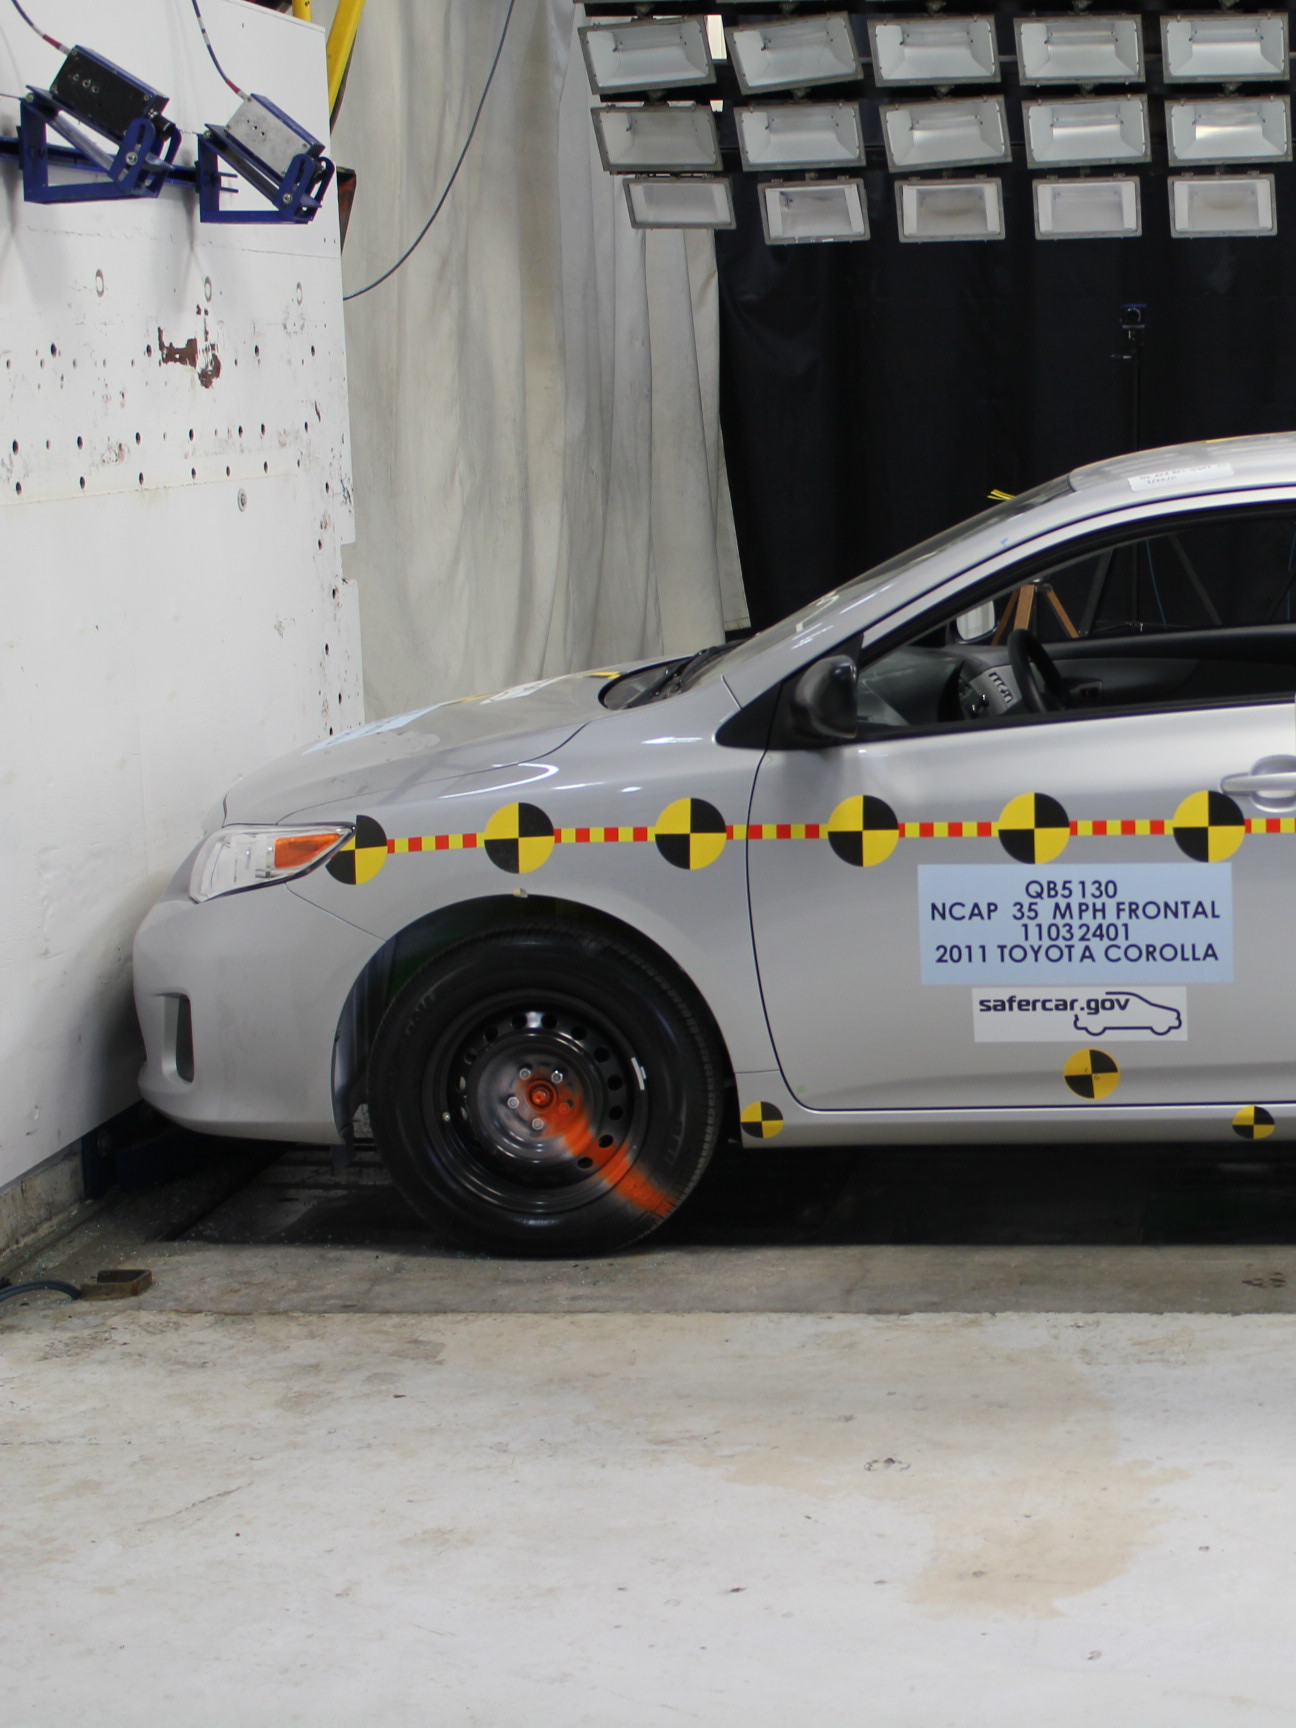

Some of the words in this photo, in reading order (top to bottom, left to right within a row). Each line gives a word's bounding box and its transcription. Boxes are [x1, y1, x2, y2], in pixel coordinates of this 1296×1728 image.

[1025, 880, 1118, 899] QB5130
[930, 902, 998, 921] NCAP
[1012, 902, 1039, 920] 35
[1052, 902, 1106, 920] MPH
[1116, 901, 1220, 920] FRONTAL
[1022, 923, 1130, 942] 11032401
[935, 945, 987, 964] 2011
[997, 944, 1095, 963] TOYOTA
[1104, 943, 1219, 963] COROLLA
[979, 996, 1130, 1015] safercar.gov
